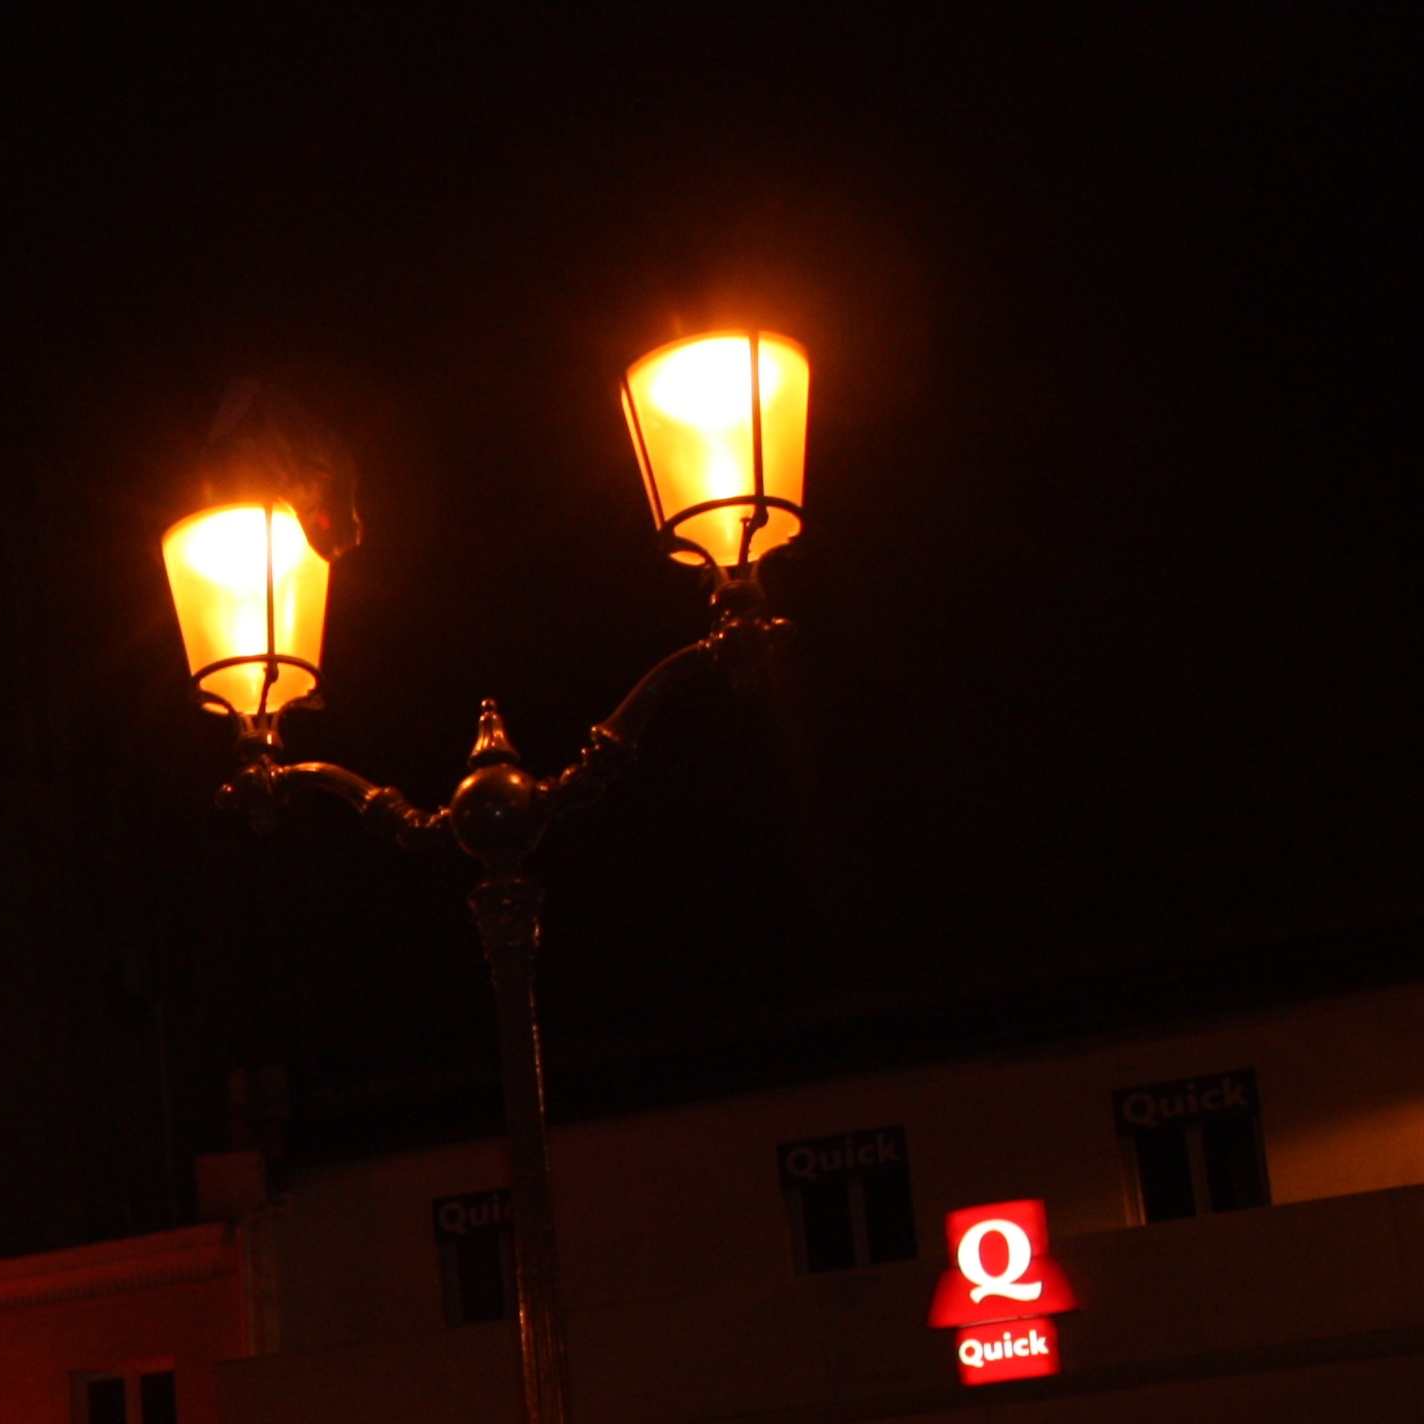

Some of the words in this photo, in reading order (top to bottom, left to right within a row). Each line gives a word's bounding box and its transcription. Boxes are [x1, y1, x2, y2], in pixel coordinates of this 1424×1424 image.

[1121, 1076, 1249, 1128] Quick
[784, 1129, 902, 1180] Quick
[957, 1219, 1043, 1305] Q
[958, 1329, 1050, 1369] Quick
